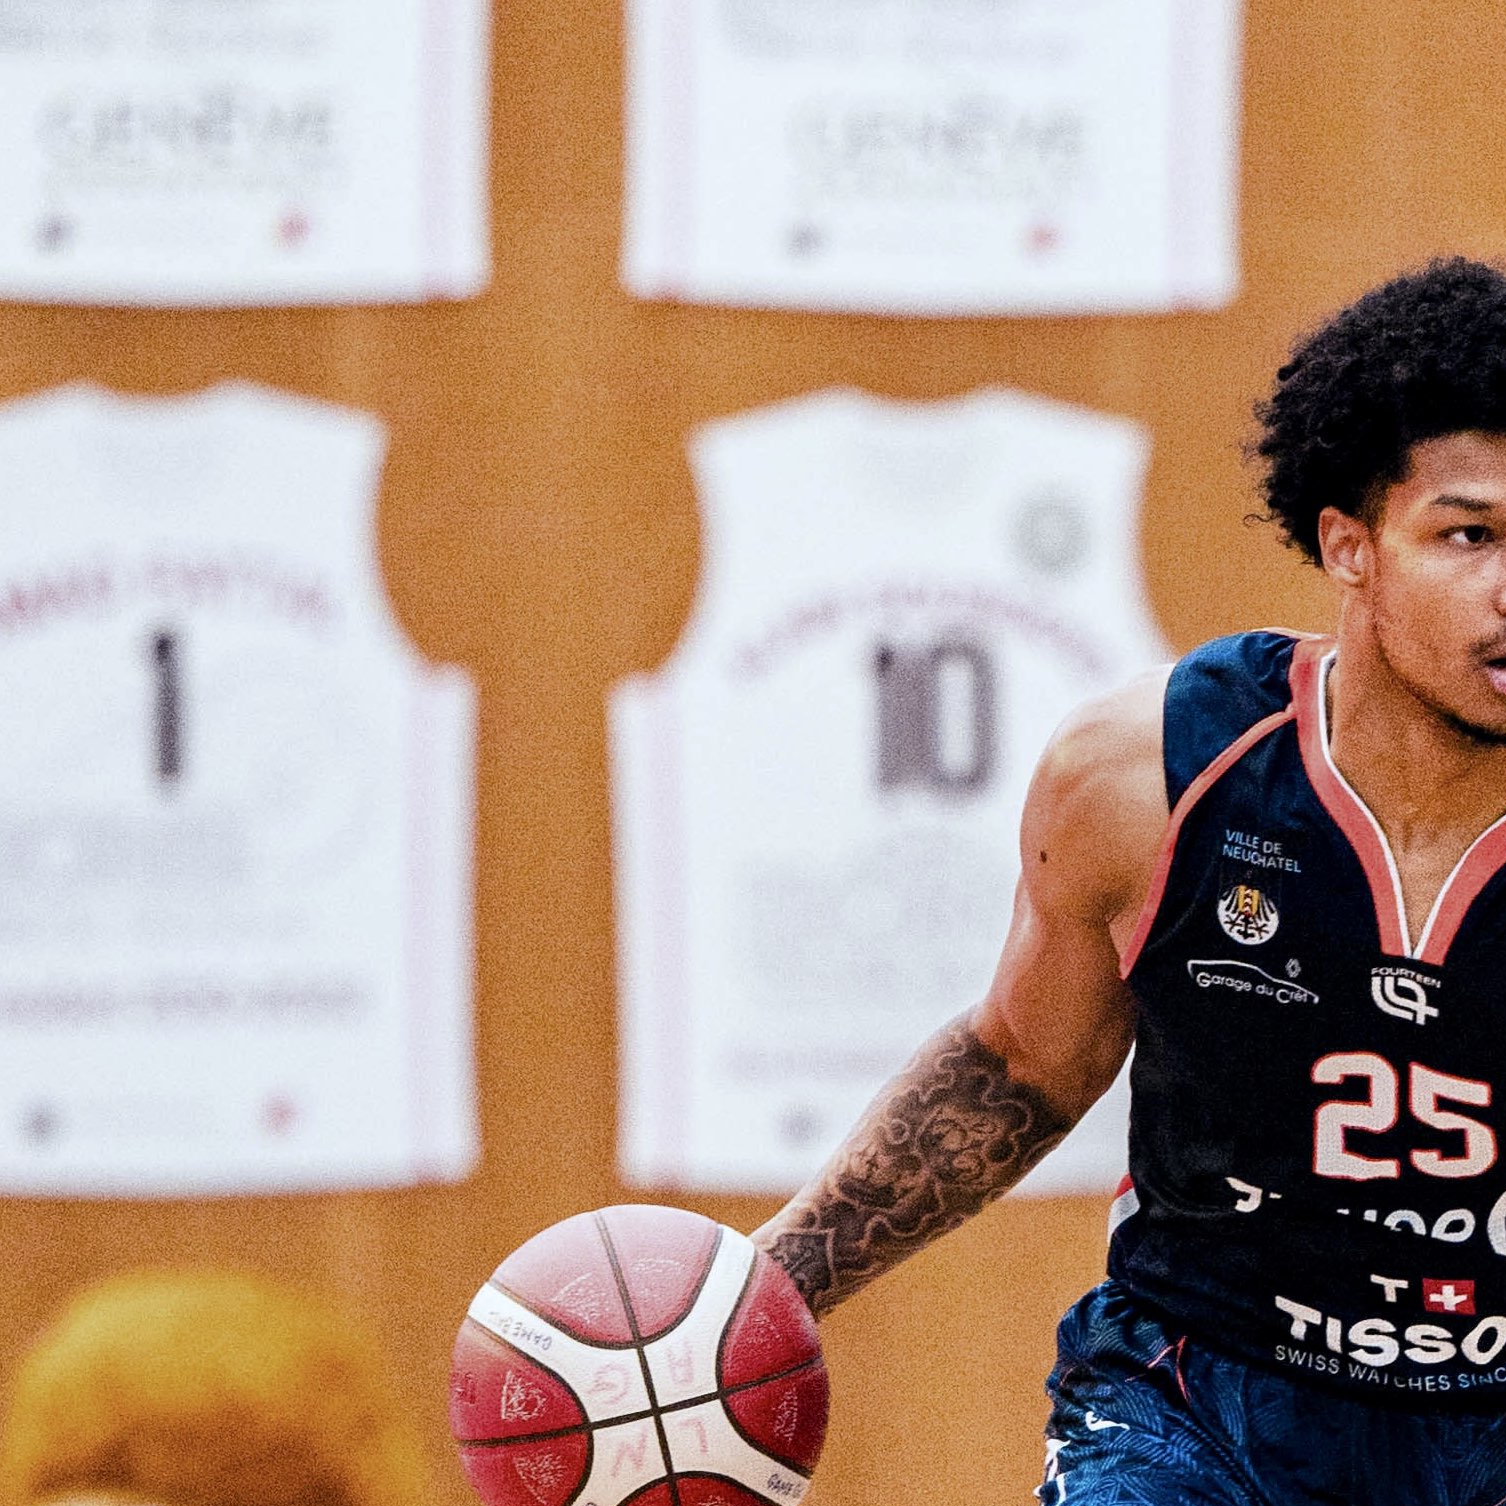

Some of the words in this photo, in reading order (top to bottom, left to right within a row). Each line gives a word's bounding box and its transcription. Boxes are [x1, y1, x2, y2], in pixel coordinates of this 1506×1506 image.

[870, 632, 1001, 801] 10
[1225, 829, 1260, 849] VILLE
[1263, 840, 1283, 855] DE
[1196, 971, 1252, 993] Garage
[1255, 983, 1274, 996] du
[1371, 966, 1442, 989] FOURTEEN
[1310, 1050, 1499, 1181] 25
[1274, 1344, 1341, 1375] SWISS
